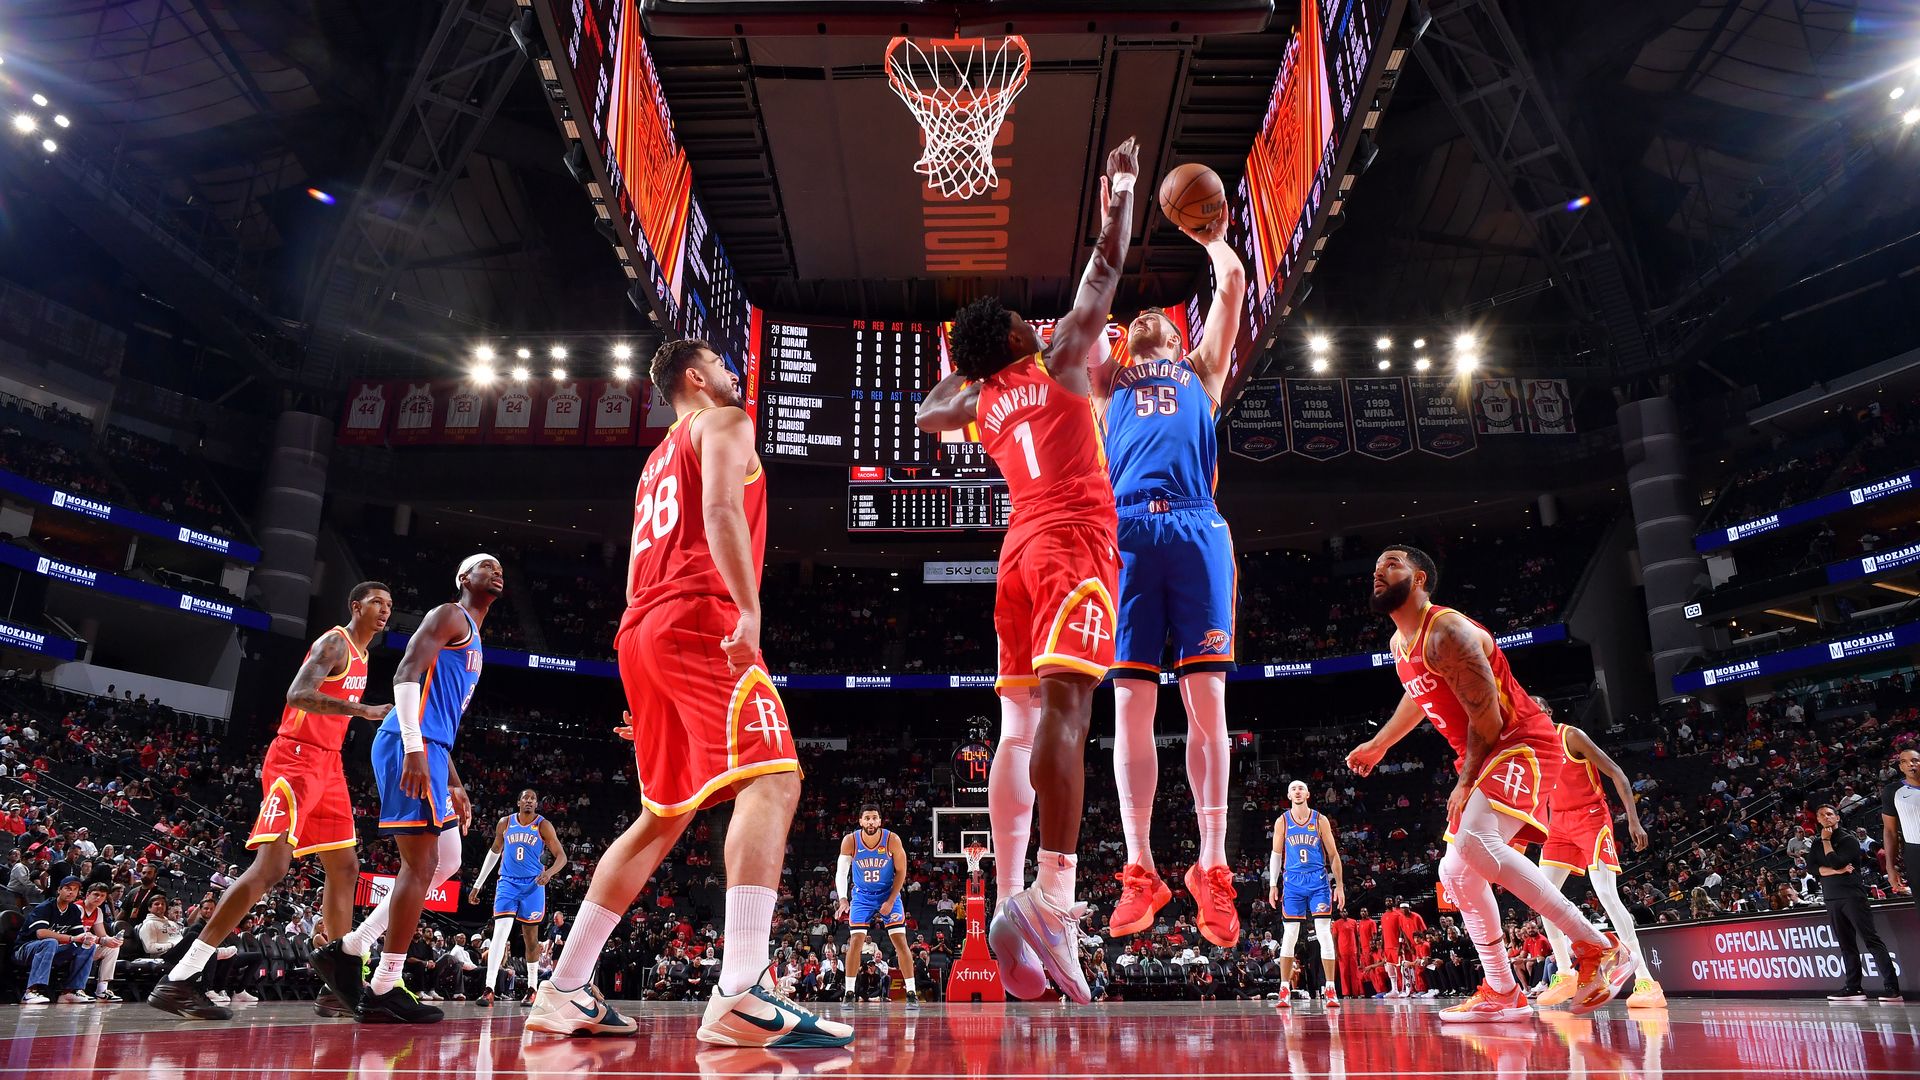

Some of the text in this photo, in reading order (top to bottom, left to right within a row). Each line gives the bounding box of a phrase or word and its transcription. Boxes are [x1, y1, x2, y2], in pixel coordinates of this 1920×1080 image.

[853, 320, 922, 332] PTS REB AST FLS
[771, 325, 920, 343] 28 SENGUN 0 0 0 0
[773, 337, 920, 354] 7 DURANT 0 0 0 0
[771, 348, 920, 366] 10 SMITH JR. 0 0 0 0
[772, 361, 920, 377] 1 THOMPSON 2 1 0 0
[1118, 363, 1192, 386] THUNDER
[771, 372, 920, 389] 5 VANVLEET 0 0 1 0
[768, 395, 860, 411] 55 HARTENSTEIN 0
[852, 390, 922, 401] PTS REB AST FLS
[1135, 386, 1178, 418] 55
[1428, 398, 1453, 406] 2000
[359, 403, 375, 414] 44
[410, 402, 425, 413] 45
[458, 402, 471, 412] 23
[506, 402, 522, 413] 24
[556, 402, 572, 413] 22
[606, 402, 622, 413] 34
[984, 384, 1049, 435] THOMPSON
[1242, 400, 1266, 408] 1997
[1304, 400, 1328, 409] 1998
[1366, 399, 1390, 408] 1999
[769, 407, 860, 422] 8 WILLIAMS 0
[1241, 410, 1271, 418] WNBA
[1302, 410, 1332, 419] WNBA
[1364, 409, 1394, 417] WNBA
[1427, 407, 1458, 416] WNBA
[769, 419, 860, 435] 9 CARUSO 0
[1231, 420, 1282, 430] Champions
[1293, 420, 1344, 430] Champions
[1355, 419, 1406, 429] Champions
[1418, 417, 1469, 427] Champions
[768, 432, 859, 447] 2 GILGEOUS-ALEXANDER 0
[765, 444, 879, 460] 25 MITCHELL 0 1
[947, 444, 973, 455] TOL FLS
[1013, 421, 1041, 480] 1
[951, 455, 984, 464] 7 0 1
[1863, 475, 1911, 495] MOKARAM
[1865, 484, 1913, 501] INJURY LAWYERS
[65, 504, 109, 520] INJURY LAWYERS
[66, 495, 111, 514] MOKARAM
[634, 474, 679, 560] 28
[1738, 515, 1778, 533] MOKARAM
[191, 531, 229, 548] MOKARAM
[1876, 545, 1920, 563] MOKARAM
[50, 562, 97, 580] MOKARAM
[49, 571, 94, 587] INJURY LAWYERS
[193, 598, 233, 614] MOKARAM
[1687, 606, 1699, 616] CC
[0, 624, 44, 644] MOKARAM
[1496, 632, 1533, 644] MOKARAM
[1843, 632, 1894, 649] MOKARAM
[1845, 641, 1896, 656] INJURY LAWYERS
[540, 657, 576, 667] MOKARAM
[1275, 663, 1311, 672] MOKARAM
[1715, 660, 1759, 676] MOKARAM
[342, 675, 367, 690] ROCKE
[1422, 702, 1447, 729] 5
[969, 762, 986, 779] 14
[507, 834, 538, 847] THUNDER
[1286, 835, 1319, 847] THUNDER
[516, 846, 524, 862] 8
[1300, 848, 1308, 864] 9
[856, 857, 887, 870] THUNDER
[864, 870, 880, 882] 25
[1715, 925, 1840, 954] OFFICIAL VEHICL
[956, 968, 996, 982] xfinity
[1692, 960, 1709, 980] OF
[1710, 959, 1737, 980] THE
[1740, 956, 1814, 979] HOUSTON
